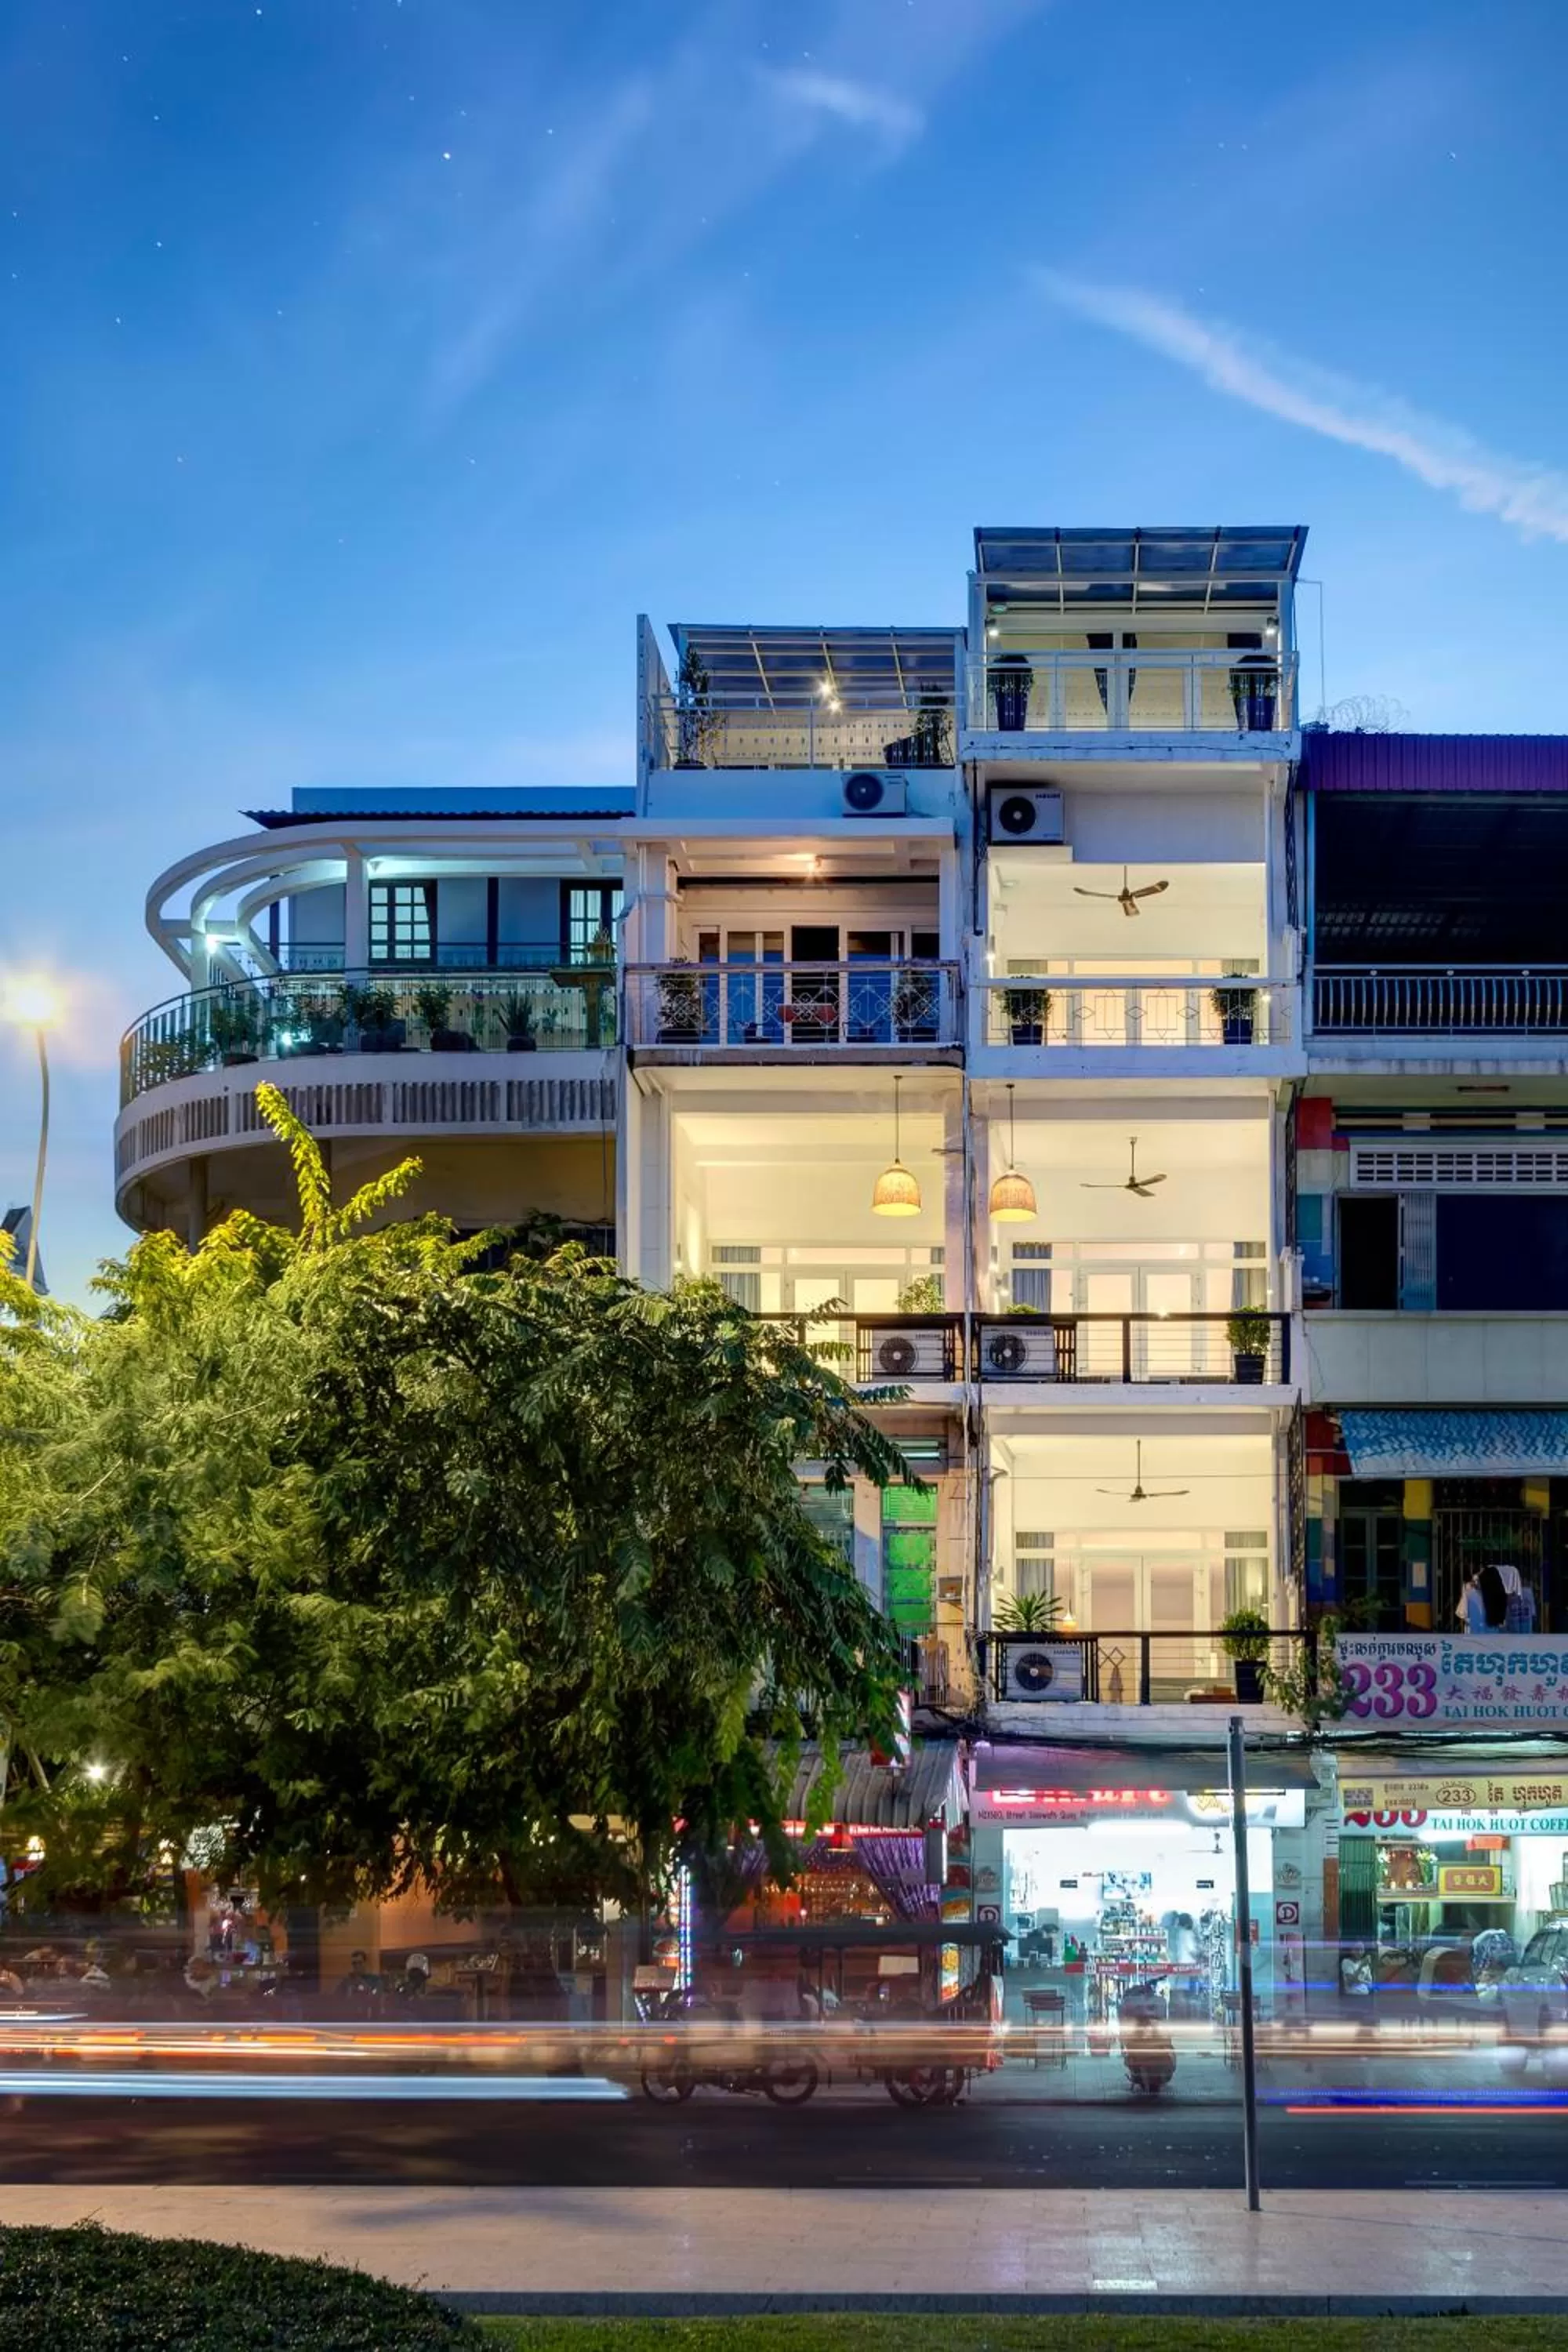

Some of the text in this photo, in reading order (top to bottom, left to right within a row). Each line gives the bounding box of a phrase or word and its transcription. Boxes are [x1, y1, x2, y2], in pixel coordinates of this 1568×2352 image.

[1341, 1662, 1438, 1719] 233
[1443, 1705, 1468, 1718] TAI
[1473, 1705, 1508, 1718] HOK
[1514, 1705, 1559, 1718] HUOT
[1442, 1790, 1471, 1802] 233
[1432, 1818, 1453, 1830] TAI
[1457, 1818, 1486, 1830] HOK
[1490, 1818, 1528, 1830] HUOT
